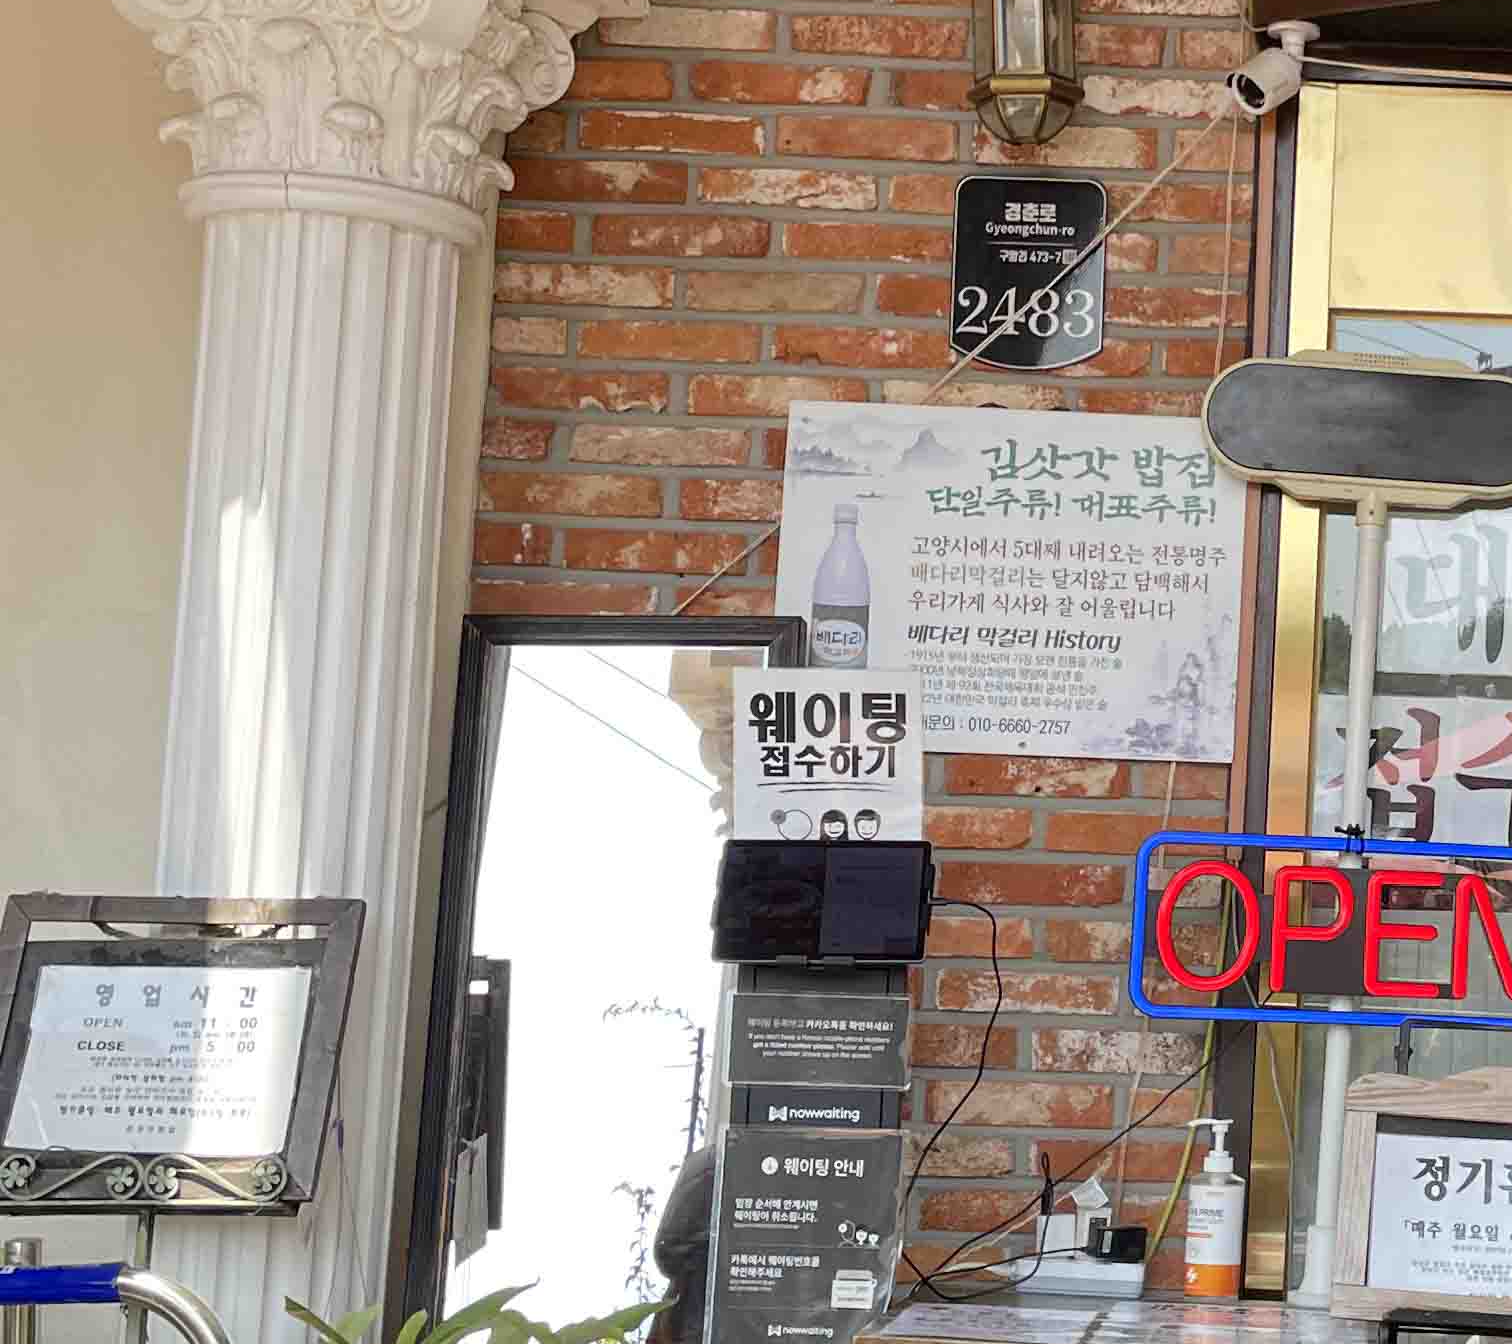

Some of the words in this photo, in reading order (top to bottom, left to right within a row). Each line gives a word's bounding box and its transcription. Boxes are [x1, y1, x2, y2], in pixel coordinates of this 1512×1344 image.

[1005, 202, 1056, 222] 경춘로
[985, 221, 1075, 238] Gyeongchun-ro
[955, 286, 1095, 338] 2483
[981, 439, 1120, 481] 김삿갓
[1132, 445, 1217, 489] 밥집
[925, 485, 1061, 521] 단일주류!
[1072, 491, 1217, 527] 대표주류!
[911, 535, 1007, 558] 고양시에서
[1069, 542, 1144, 564] 내려오는
[1151, 543, 1227, 568] 전통명주
[911, 563, 1045, 589] 배다리막걸리는
[1052, 567, 1128, 591] 달지않고
[1134, 572, 1209, 594] 담백해서
[908, 590, 984, 615] 우리가게
[991, 593, 1049, 617] 식사와
[1057, 595, 1075, 618] 잘
[1080, 597, 1176, 621] 어울립니다
[908, 624, 968, 646] 배다리
[977, 626, 1037, 648] 막걸리
[1044, 630, 1121, 654] History
[748, 691, 907, 744] 웨이팅
[968, 716, 1071, 736] 010-6660-2757
[760, 745, 896, 778] 접수하기
[83, 1017, 124, 1029] OPEN
[77, 1040, 126, 1052] CLOSE
[789, 1106, 861, 1123] nowwaiting
[783, 1157, 829, 1177] 웨이팅
[834, 1159, 865, 1178] 안내
[1453, 1222, 1499, 1241] 월요일
